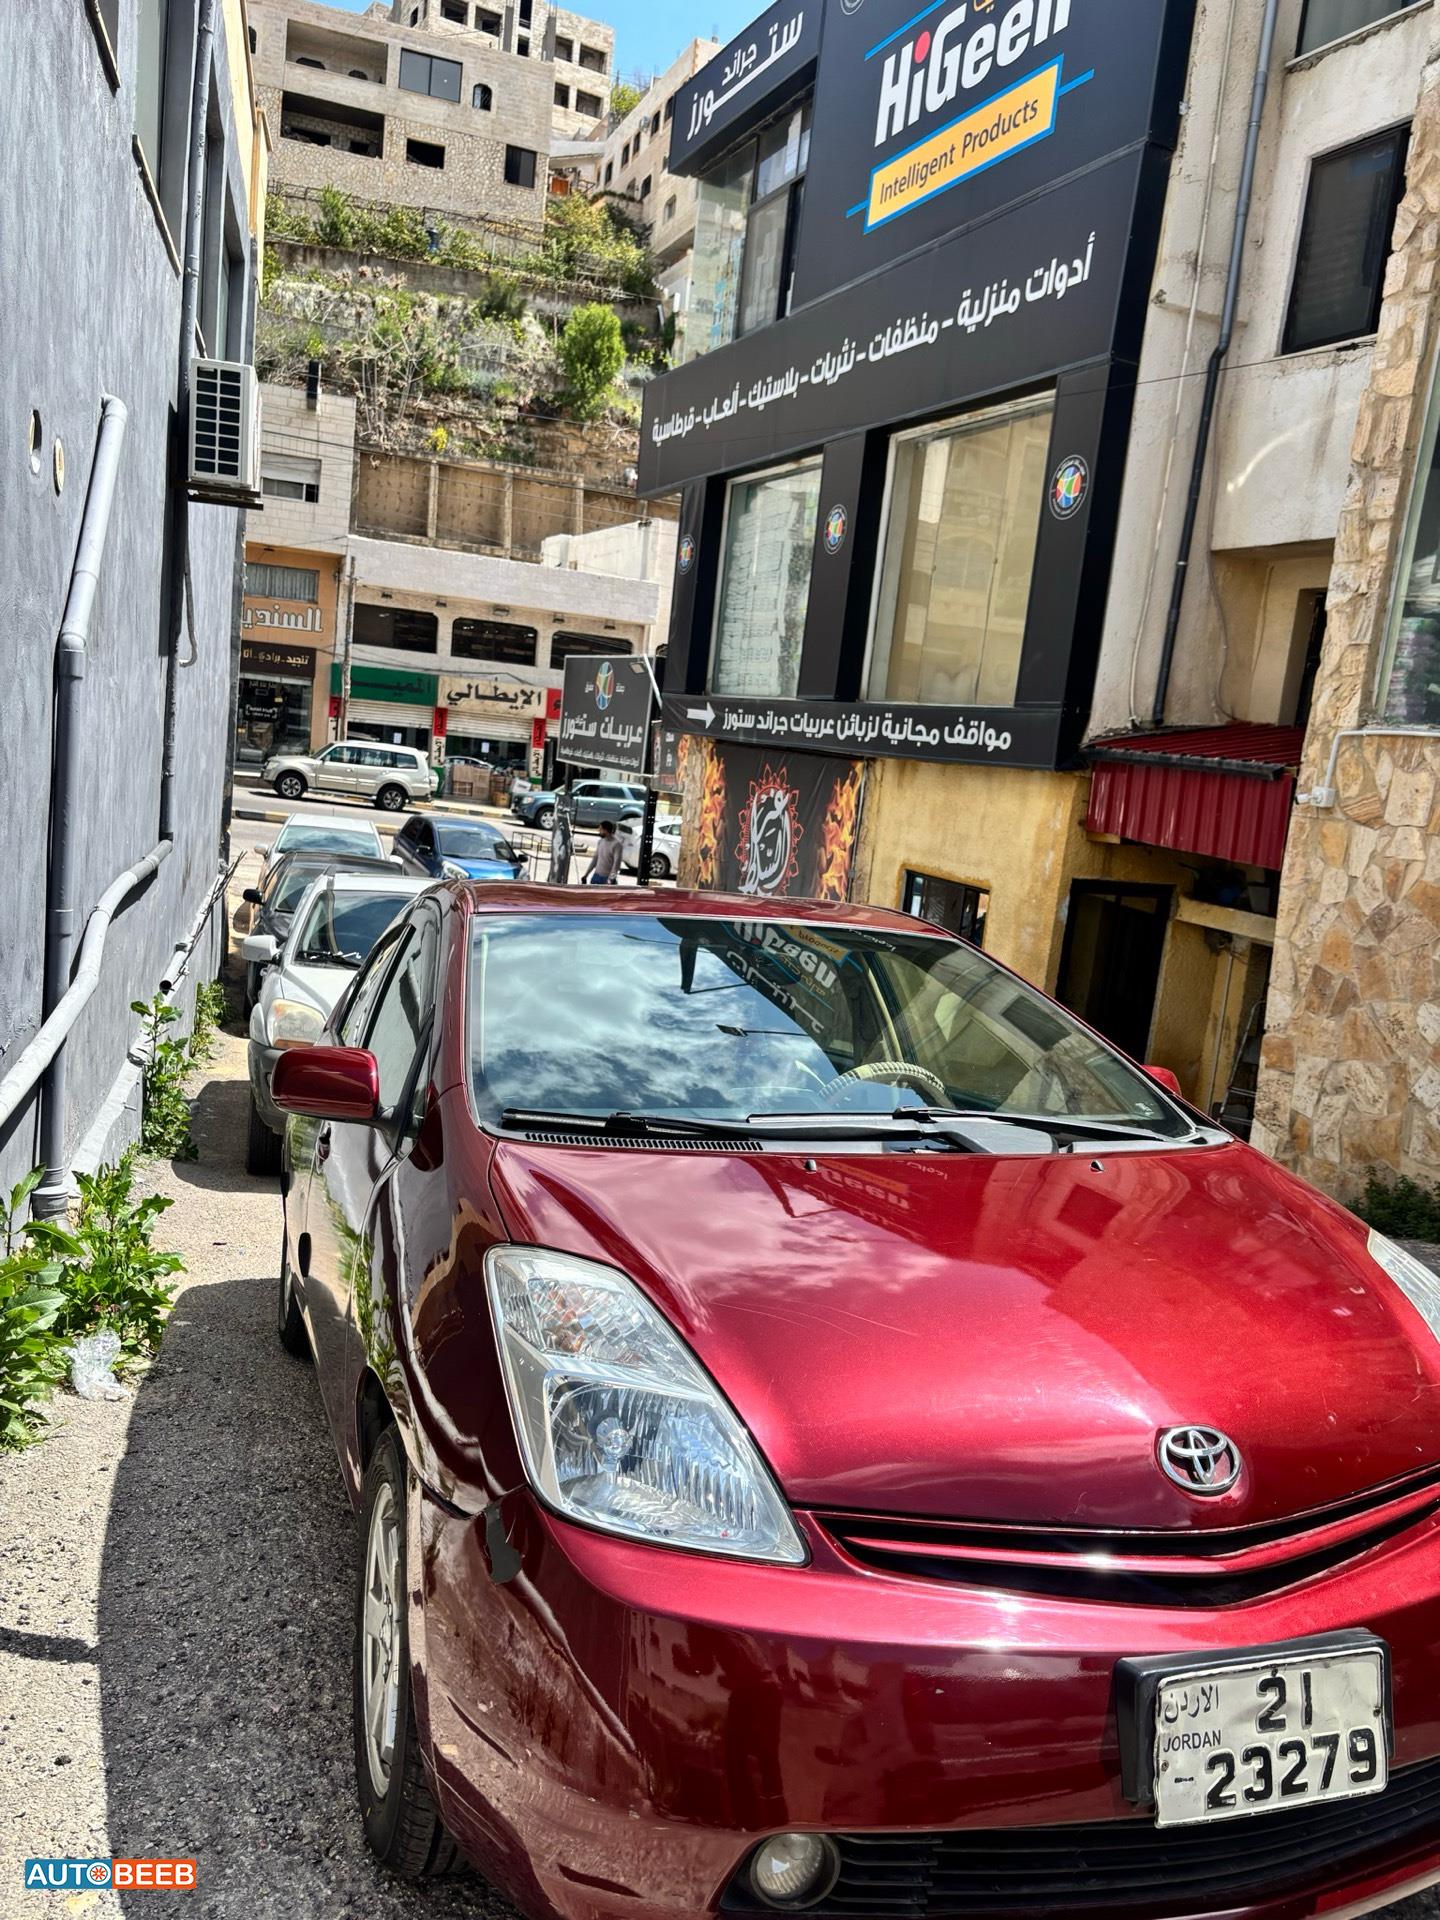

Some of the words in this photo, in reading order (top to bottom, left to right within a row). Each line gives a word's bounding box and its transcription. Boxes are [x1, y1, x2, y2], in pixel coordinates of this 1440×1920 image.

[722, 43, 757, 86] جراند
[874, 0, 1071, 148] HiGeen
[880, 143, 955, 206] Intelligent
[961, 98, 1039, 158] Products
[1025, 231, 1096, 302] أدوات
[957, 279, 1021, 334] منزلية
[868, 311, 939, 363] منظفات
[810, 337, 857, 386] نثريات
[703, 381, 740, 430] ألعاب
[748, 366, 800, 411] بلاستيك
[652, 406, 695, 448] قرطاسية
[722, 708, 756, 731] ستورز
[756, 710, 788, 735] جراند
[836, 713, 880, 742] لزبائن
[881, 712, 940, 747] مجانية
[943, 716, 1012, 752] مواقف
[1257, 1670, 1313, 1732] 21
[1162, 1729, 1222, 1753] JORDAN
[1204, 1726, 1378, 1810] 23279
